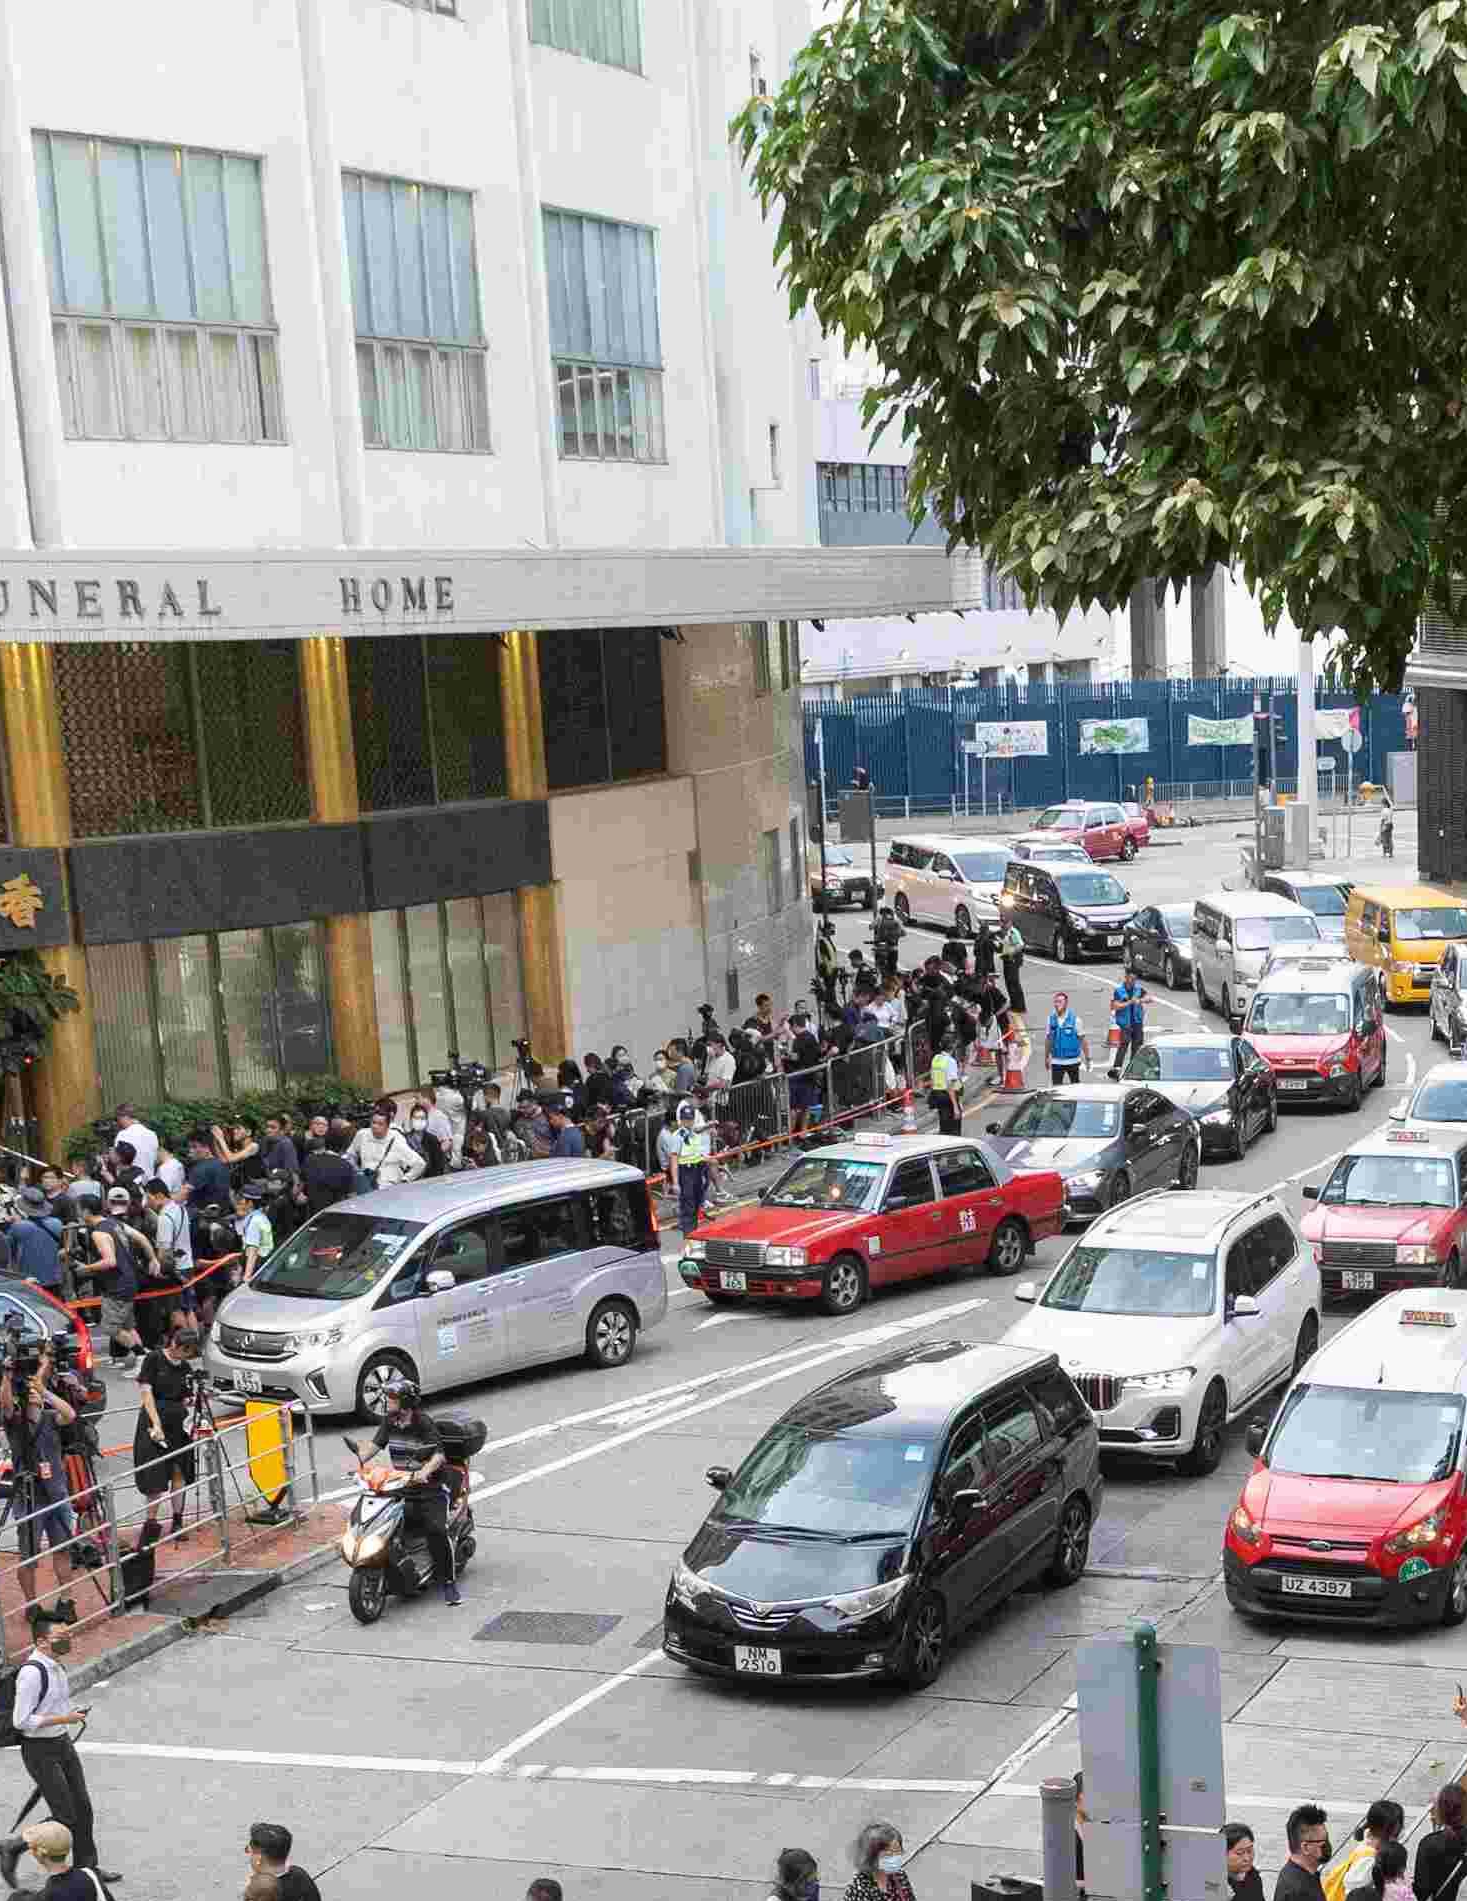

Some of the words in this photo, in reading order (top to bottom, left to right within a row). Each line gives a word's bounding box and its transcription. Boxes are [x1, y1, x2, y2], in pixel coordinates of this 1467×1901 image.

[339, 576, 454, 613] HOME
[748, 1647, 767, 1659] NM
[740, 1658, 776, 1672] 2510
